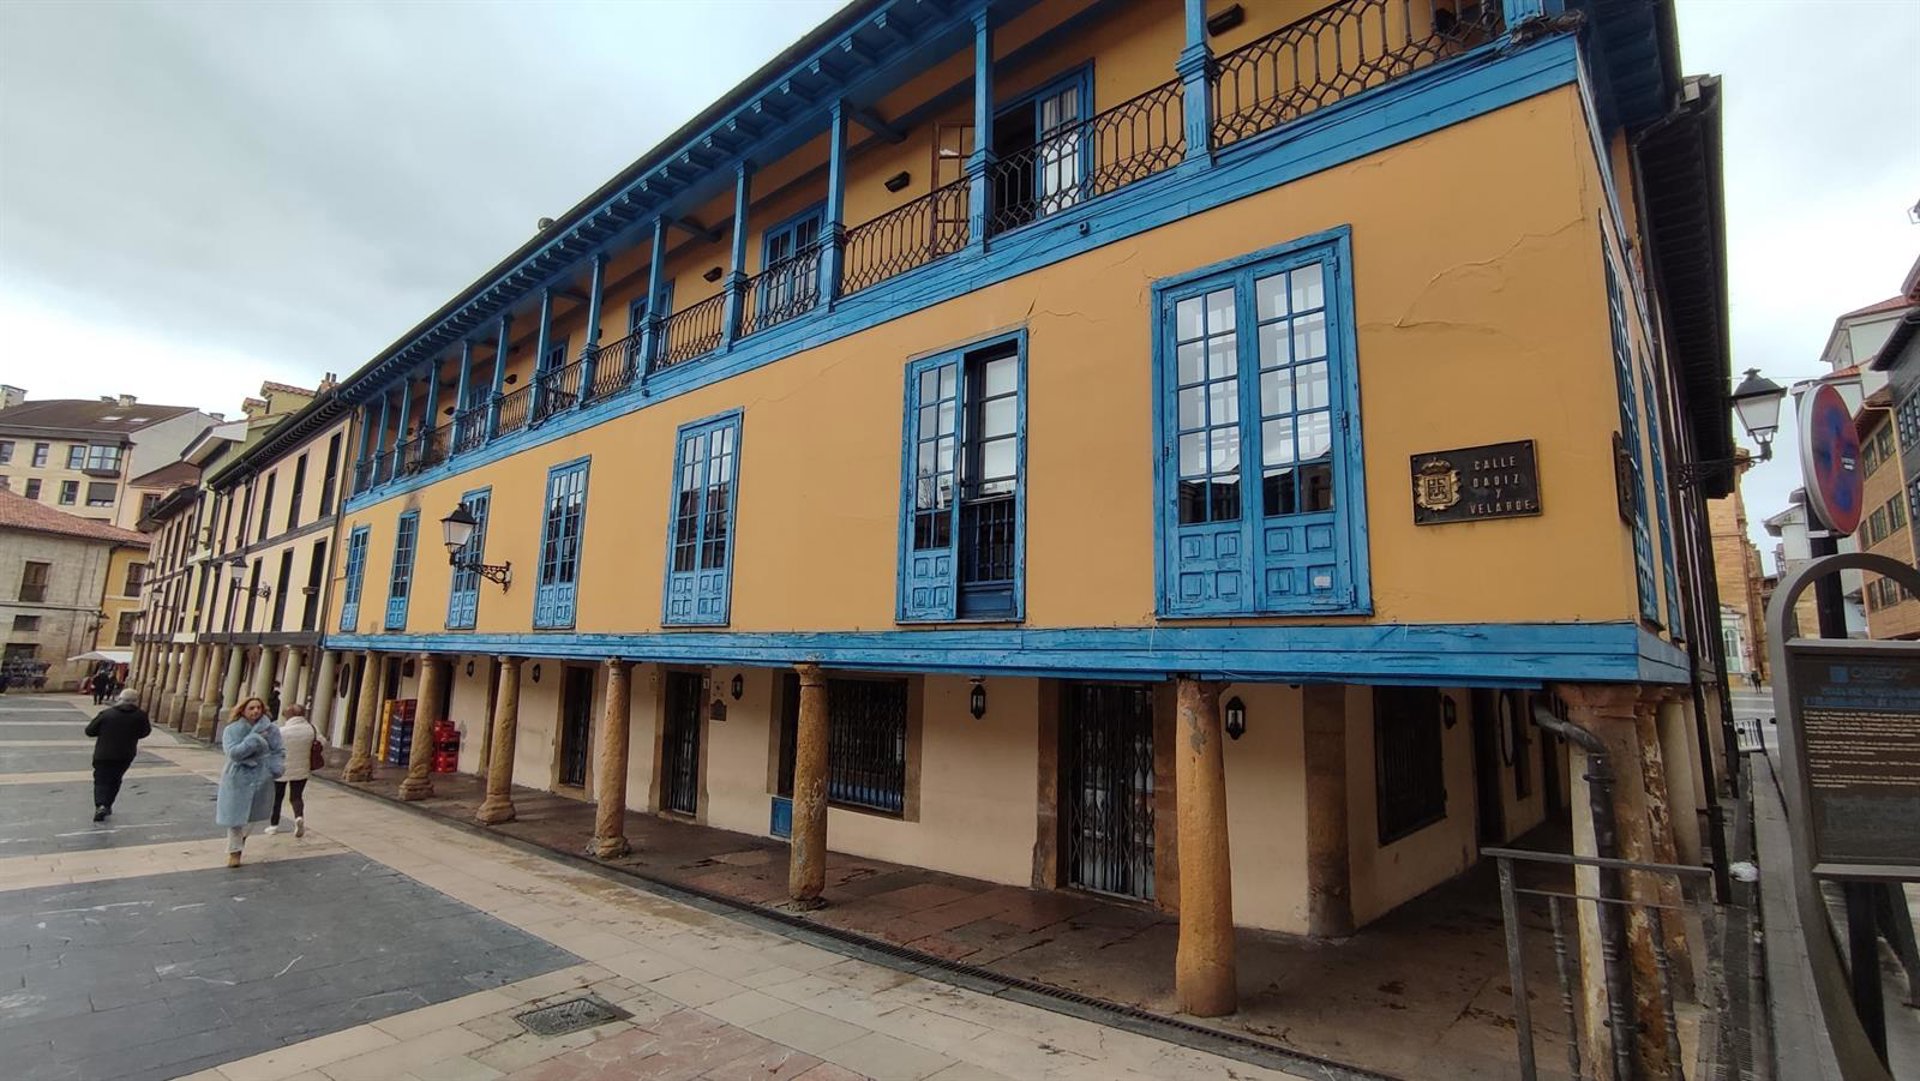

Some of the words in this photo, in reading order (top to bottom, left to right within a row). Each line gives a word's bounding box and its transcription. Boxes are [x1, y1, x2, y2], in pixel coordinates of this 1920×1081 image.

[1474, 456, 1517, 470] CALLE
[1495, 488, 1501, 499] Y
[1470, 499, 1532, 514] VELARDE
